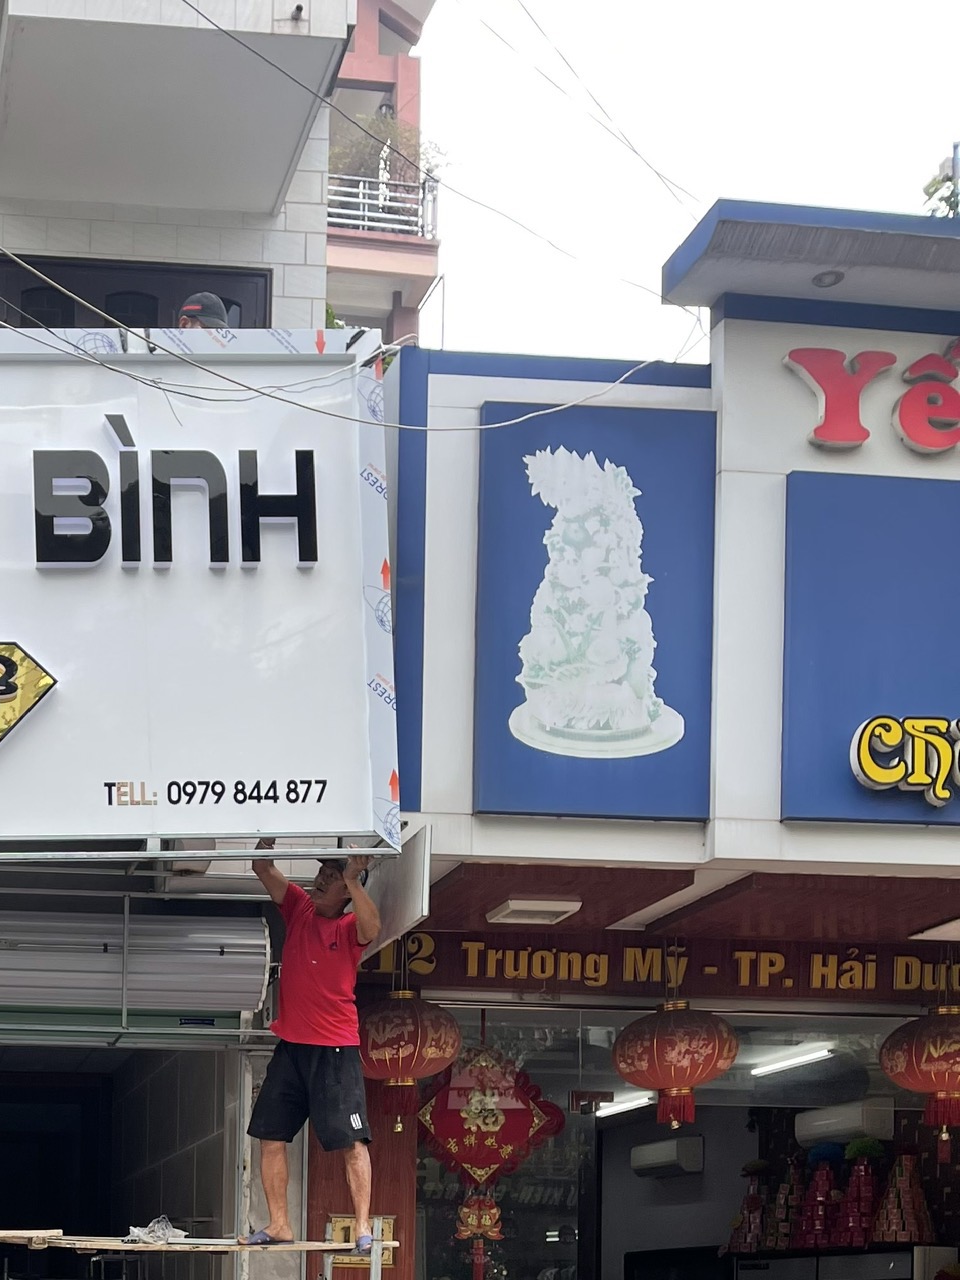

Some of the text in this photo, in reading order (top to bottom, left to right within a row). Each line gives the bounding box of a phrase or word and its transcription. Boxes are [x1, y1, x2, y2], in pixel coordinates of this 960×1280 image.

[103, 779, 328, 806] TELL: 0979 844 877
[461, 941, 609, 987] Trương
[623, 946, 689, 988] Mỹ
[733, 951, 794, 988] TP.
[810, 947, 877, 989] Hải
